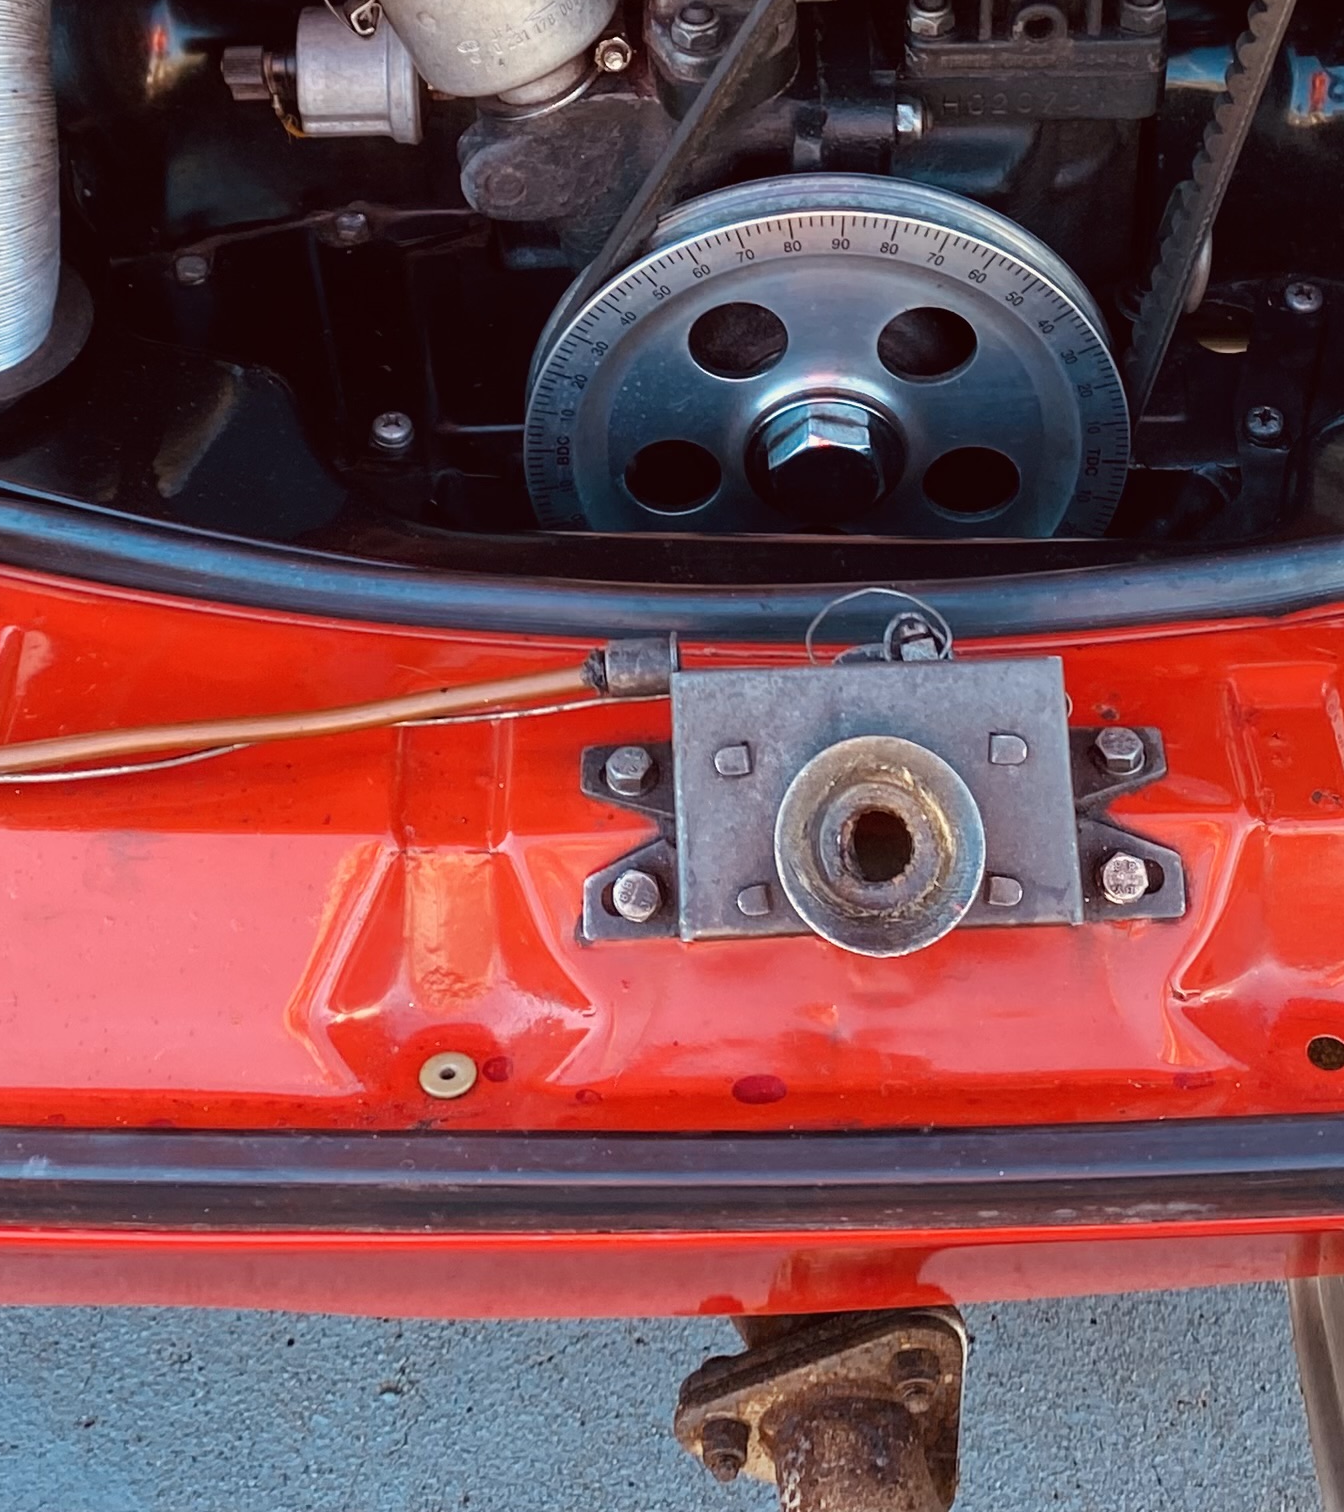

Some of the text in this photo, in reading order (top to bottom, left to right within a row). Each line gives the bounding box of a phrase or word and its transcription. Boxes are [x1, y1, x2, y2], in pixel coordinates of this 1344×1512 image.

[533, 14, 557, 34] 178
[783, 240, 802, 254] 80
[831, 238, 850, 251] 90
[879, 242, 899, 256] 80
[735, 248, 755, 264] 70
[925, 252, 945, 267] 70
[692, 264, 711, 279] 60
[968, 268, 987, 284] 60
[652, 284, 672, 301] 50
[1005, 291, 1024, 307] 50
[619, 311, 637, 328] 40
[1038, 319, 1055, 335] 40
[591, 341, 609, 358] 30
[1060, 349, 1078, 365] 30
[572, 374, 588, 390] 20
[1077, 383, 1093, 398] 20
[560, 408, 575, 422] 10
[1087, 421, 1101, 435] 10
[557, 436, 571, 466] BDC
[1084, 447, 1102, 477] TDC
